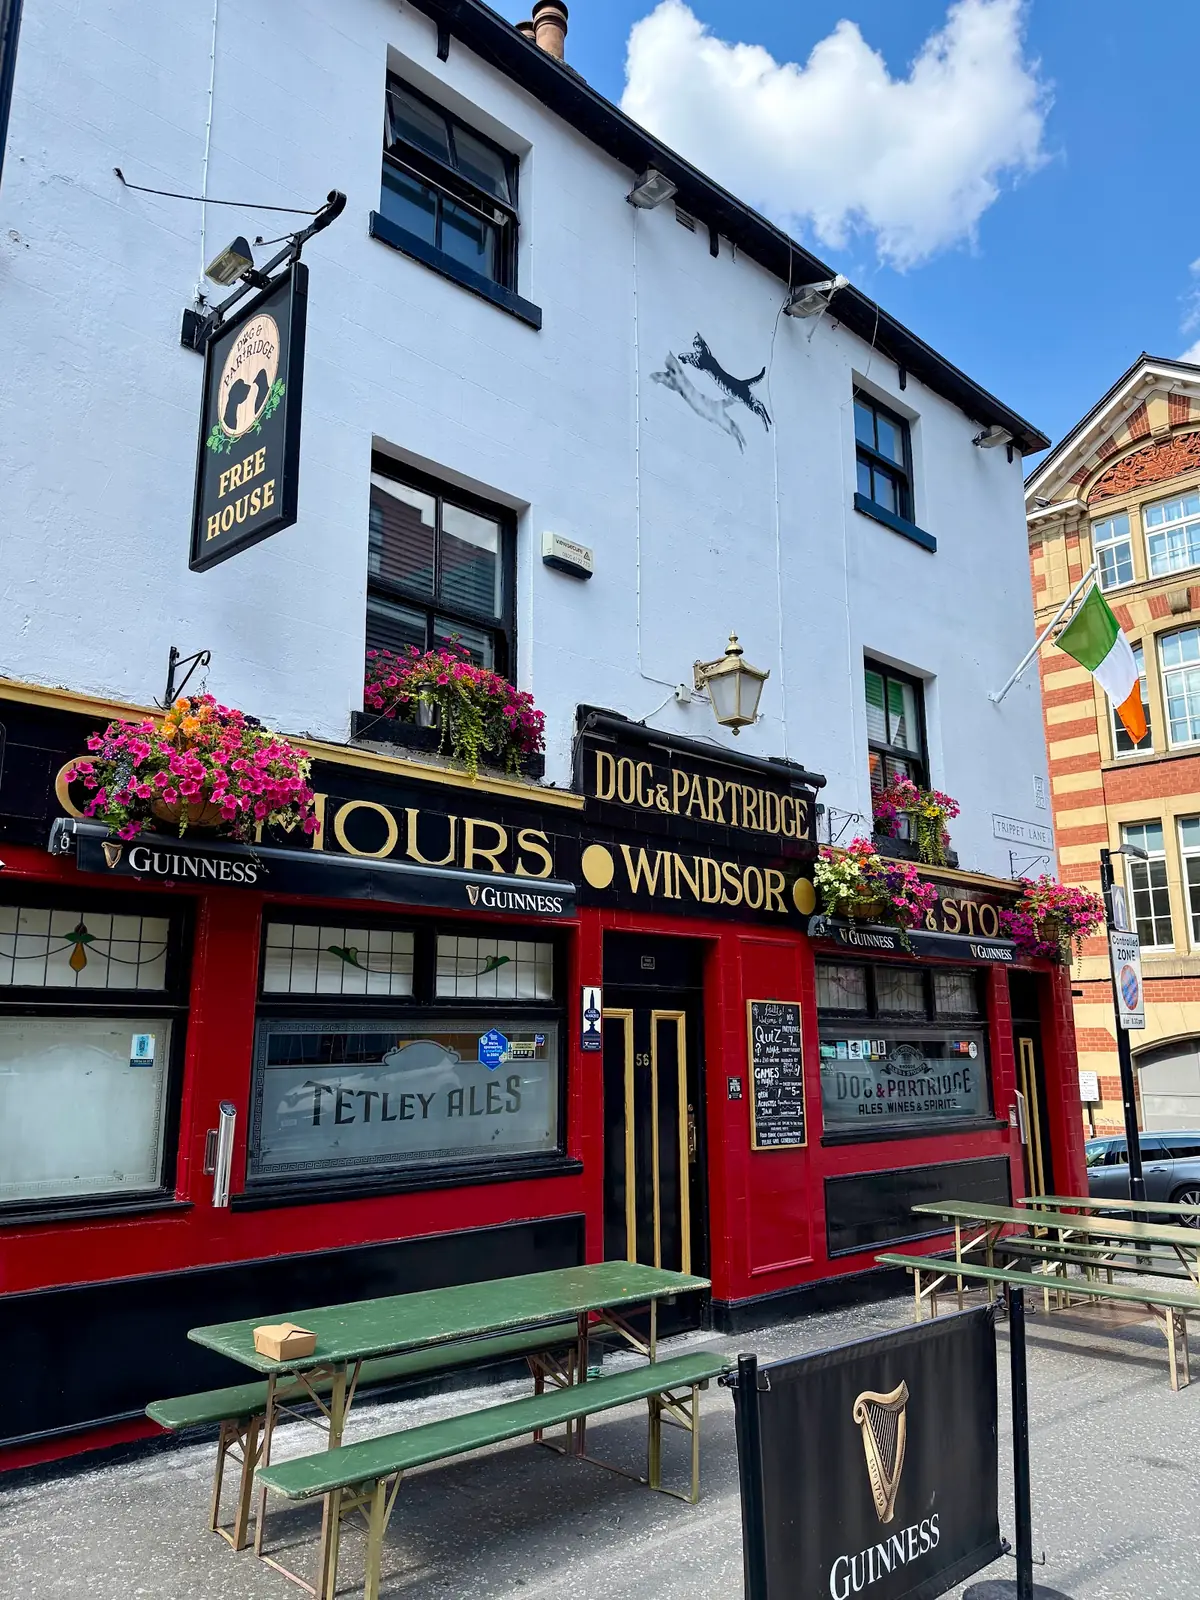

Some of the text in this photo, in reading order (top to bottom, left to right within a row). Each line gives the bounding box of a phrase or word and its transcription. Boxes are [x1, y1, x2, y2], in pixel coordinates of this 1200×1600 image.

[218, 447, 266, 499] FREE
[206, 480, 275, 541] HOUSE
[671, 768, 809, 840] PARTRIDGE
[997, 821, 1046, 843] TRIPPET LANE
[128, 846, 258, 884] GUINNESS
[619, 844, 789, 914] WINDSOR
[481, 886, 562, 914] GUINNESS
[1112, 935, 1139, 947] Controlled
[1117, 948, 1136, 961] ZONE
[635, 1053, 650, 1067] 56
[754, 1067, 780, 1079] GAMES
[836, 1068, 972, 1100] DOG & PARTRIDGE
[302, 1074, 522, 1126] TETLEY ALES
[887, 1100, 916, 1113] WINES
[916, 1102, 923, 1111] &
[873, 1480, 885, 1507] 1759
[829, 1513, 941, 1600] GUINNESS
